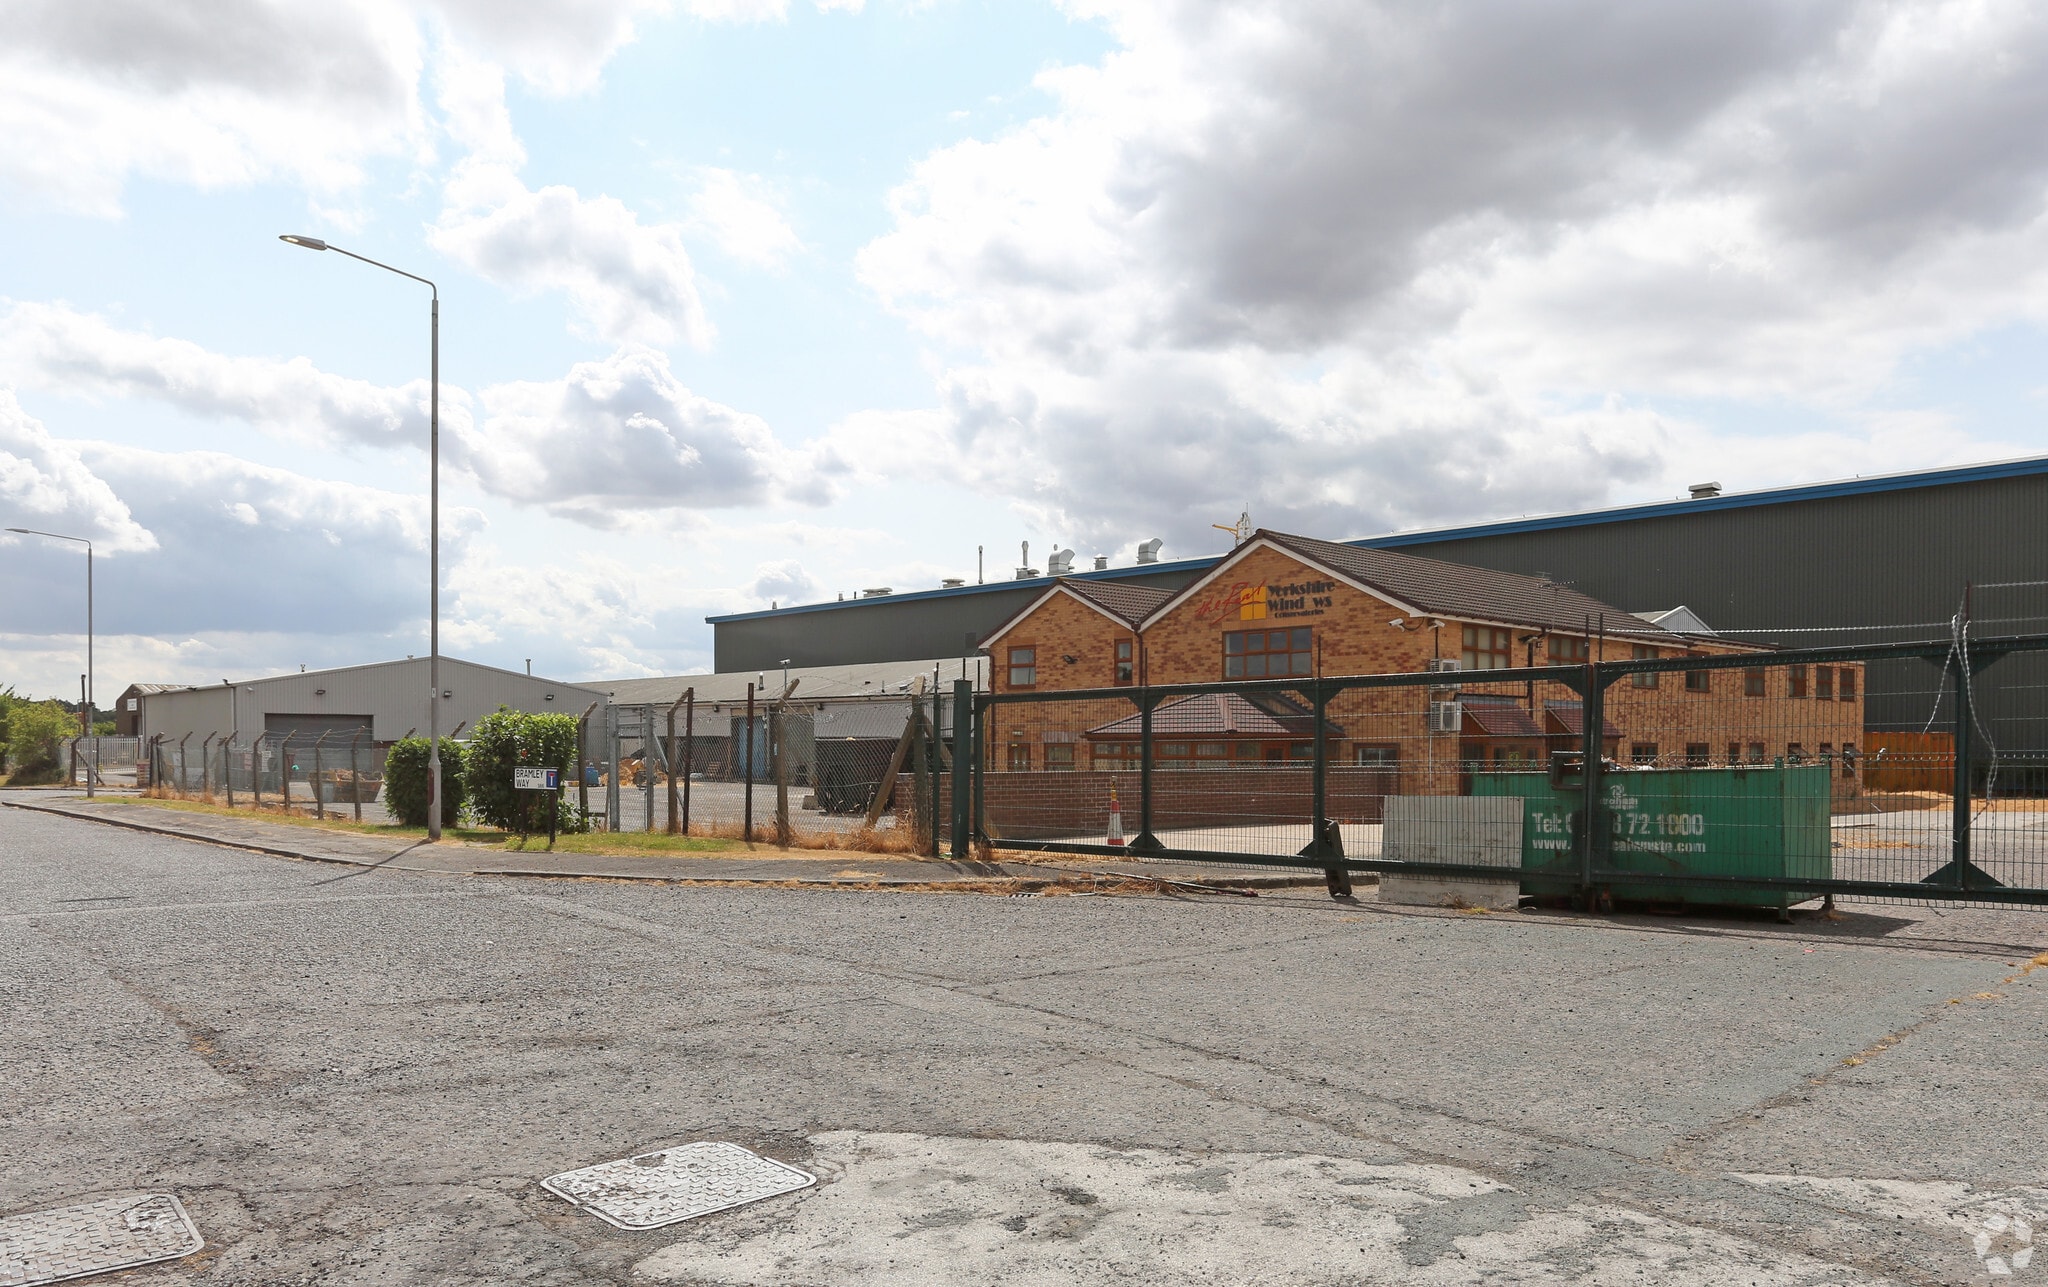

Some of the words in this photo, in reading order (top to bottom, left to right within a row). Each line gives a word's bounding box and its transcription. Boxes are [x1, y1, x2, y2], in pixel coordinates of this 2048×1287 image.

[1268, 581, 1335, 596] Yorkshire
[516, 769, 544, 779] BRAMLEY
[516, 779, 530, 787] WAY
[1531, 812, 1562, 833] Tel:
[1656, 813, 1705, 836] 1000
